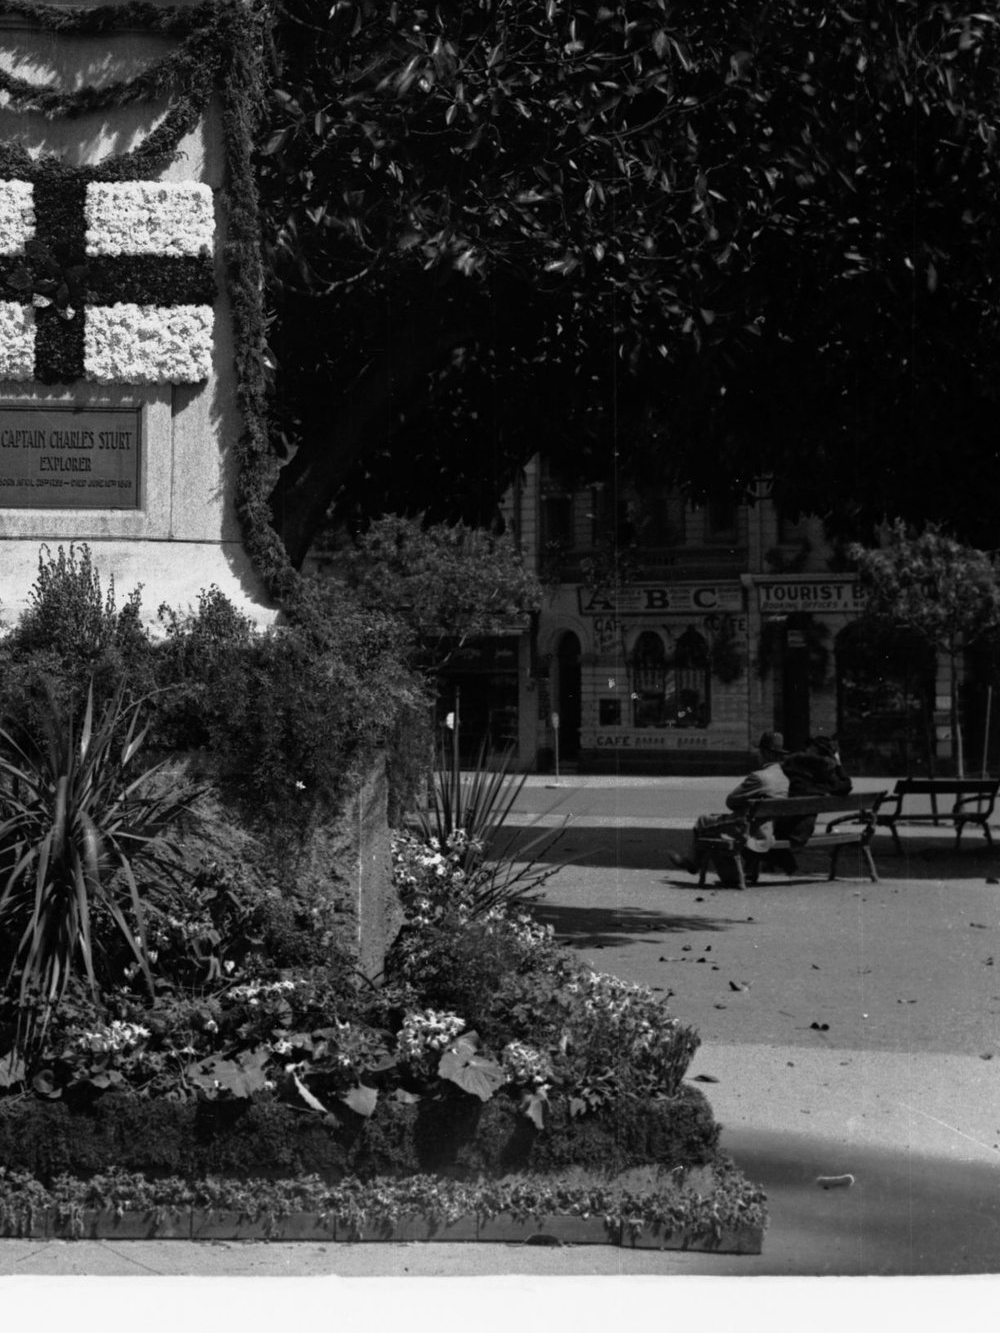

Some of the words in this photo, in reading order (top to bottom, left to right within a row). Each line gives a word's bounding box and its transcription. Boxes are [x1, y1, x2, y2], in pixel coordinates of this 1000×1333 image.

[0, 429, 46, 448] CAPTAIN
[49, 431, 95, 449] CHARLES
[98, 431, 133, 450] STURT
[39, 456, 92, 472] EXPLORER
[644, 589, 669, 609] B
[693, 588, 717, 609] C
[762, 586, 845, 600] TOURIST
[710, 617, 746, 631] CFE
[596, 736, 631, 746] CAFE
